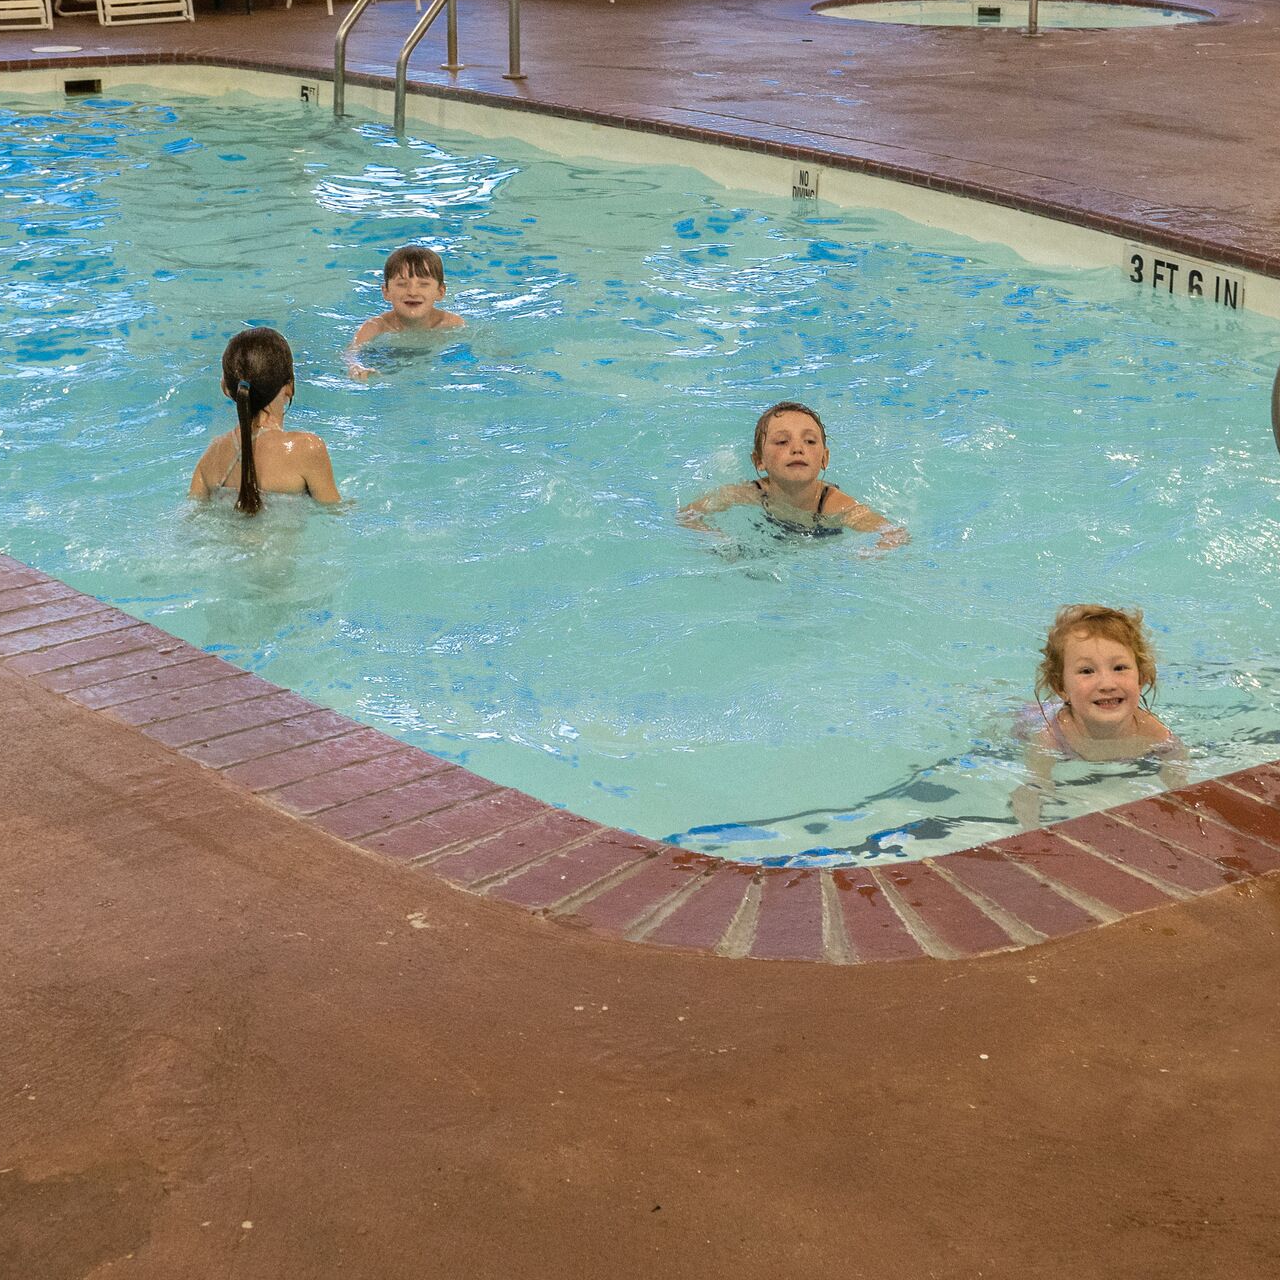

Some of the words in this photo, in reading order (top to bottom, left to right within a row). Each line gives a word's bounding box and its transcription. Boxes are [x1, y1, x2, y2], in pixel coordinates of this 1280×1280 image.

[300, 85, 309, 102] 5
[799, 169, 809, 187] NO
[1130, 254, 1143, 283] 3
[1152, 259, 1179, 294] FT
[1188, 270, 1203, 296] 6
[1215, 276, 1237, 310] IN
